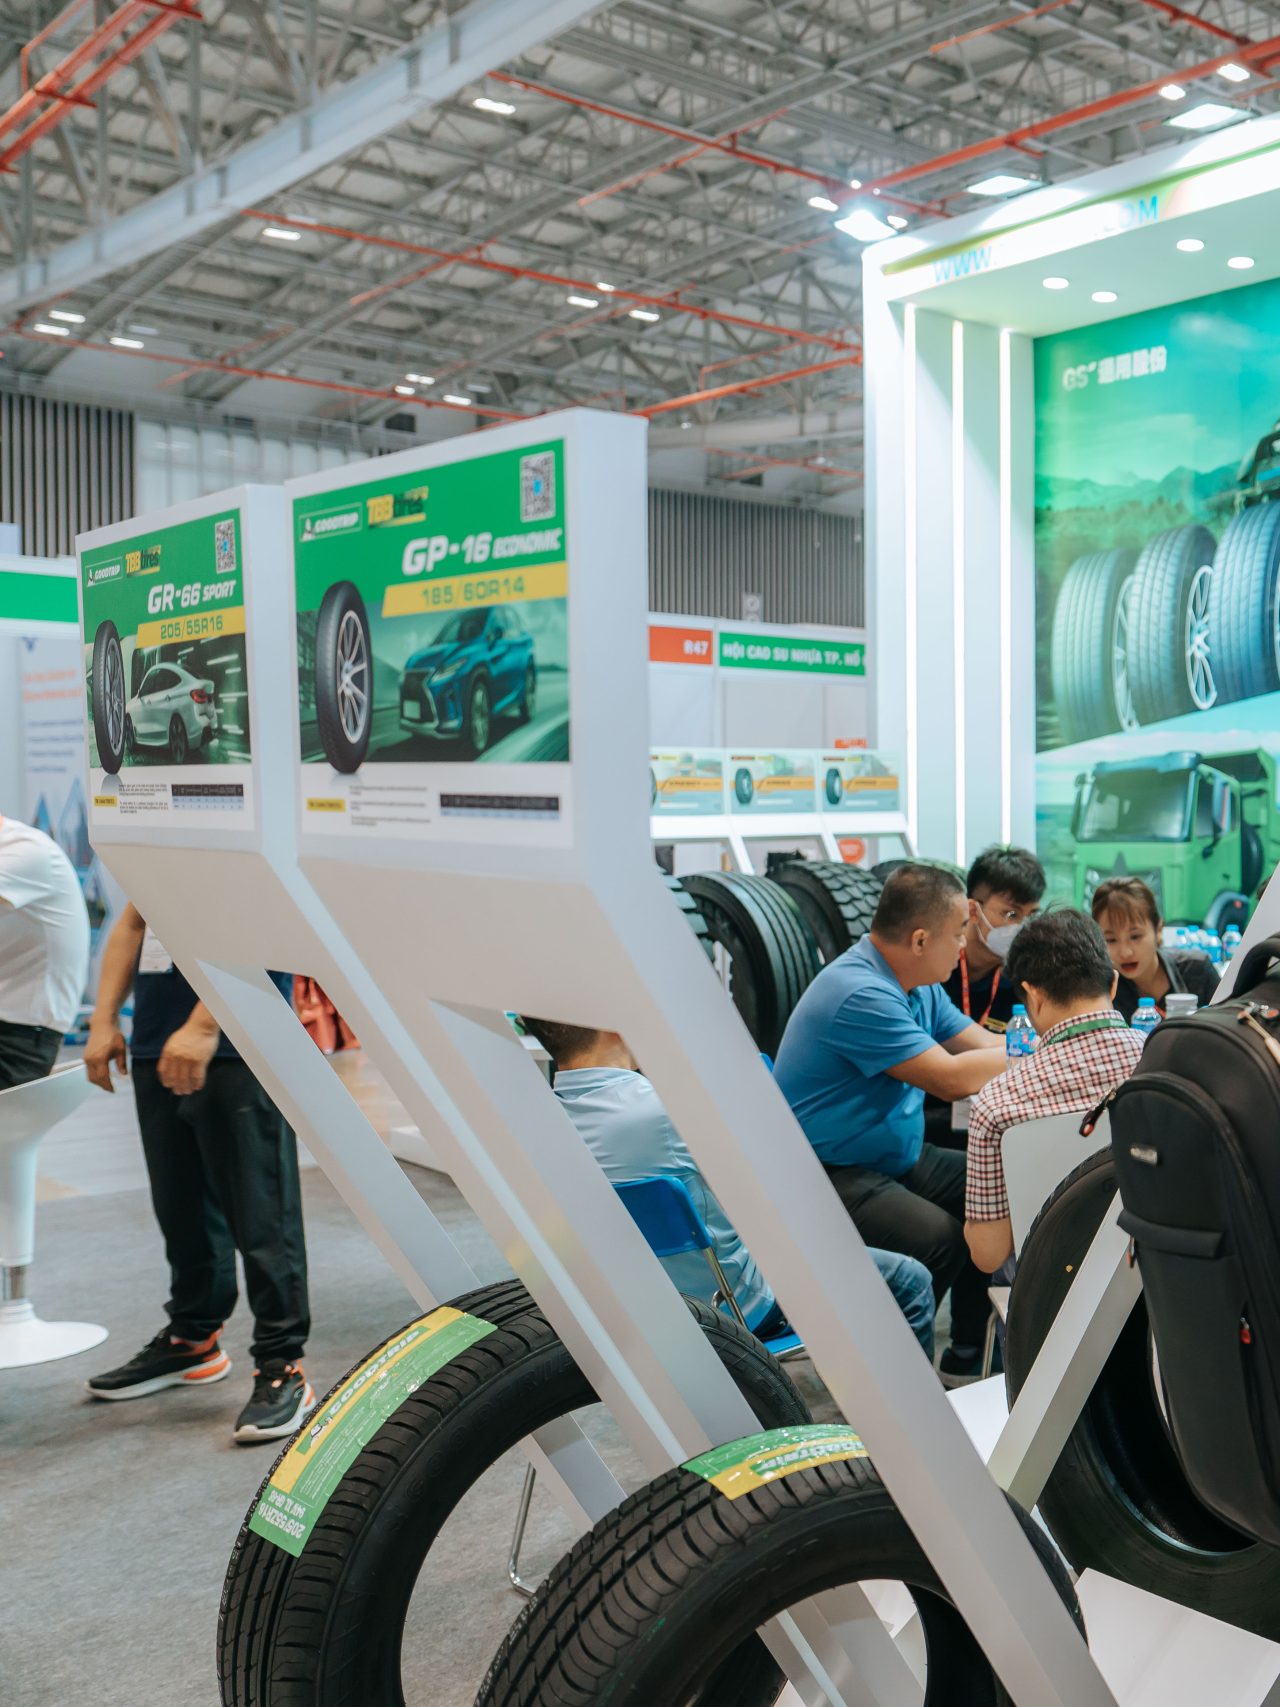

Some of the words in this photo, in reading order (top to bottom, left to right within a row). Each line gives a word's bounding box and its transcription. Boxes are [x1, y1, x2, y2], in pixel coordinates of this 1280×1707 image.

[402, 532, 492, 576] GP-16
[94, 564, 121, 580] GOODTRIP
[148, 582, 201, 614] GR-66
[202, 580, 236, 602] SPORT
[160, 615, 223, 639] 205/55R16
[683, 639, 709, 656] R47
[747, 643, 771, 660] CAO
[772, 647, 788, 662] SU
[329, 1330, 420, 1416] GOODTRIP
